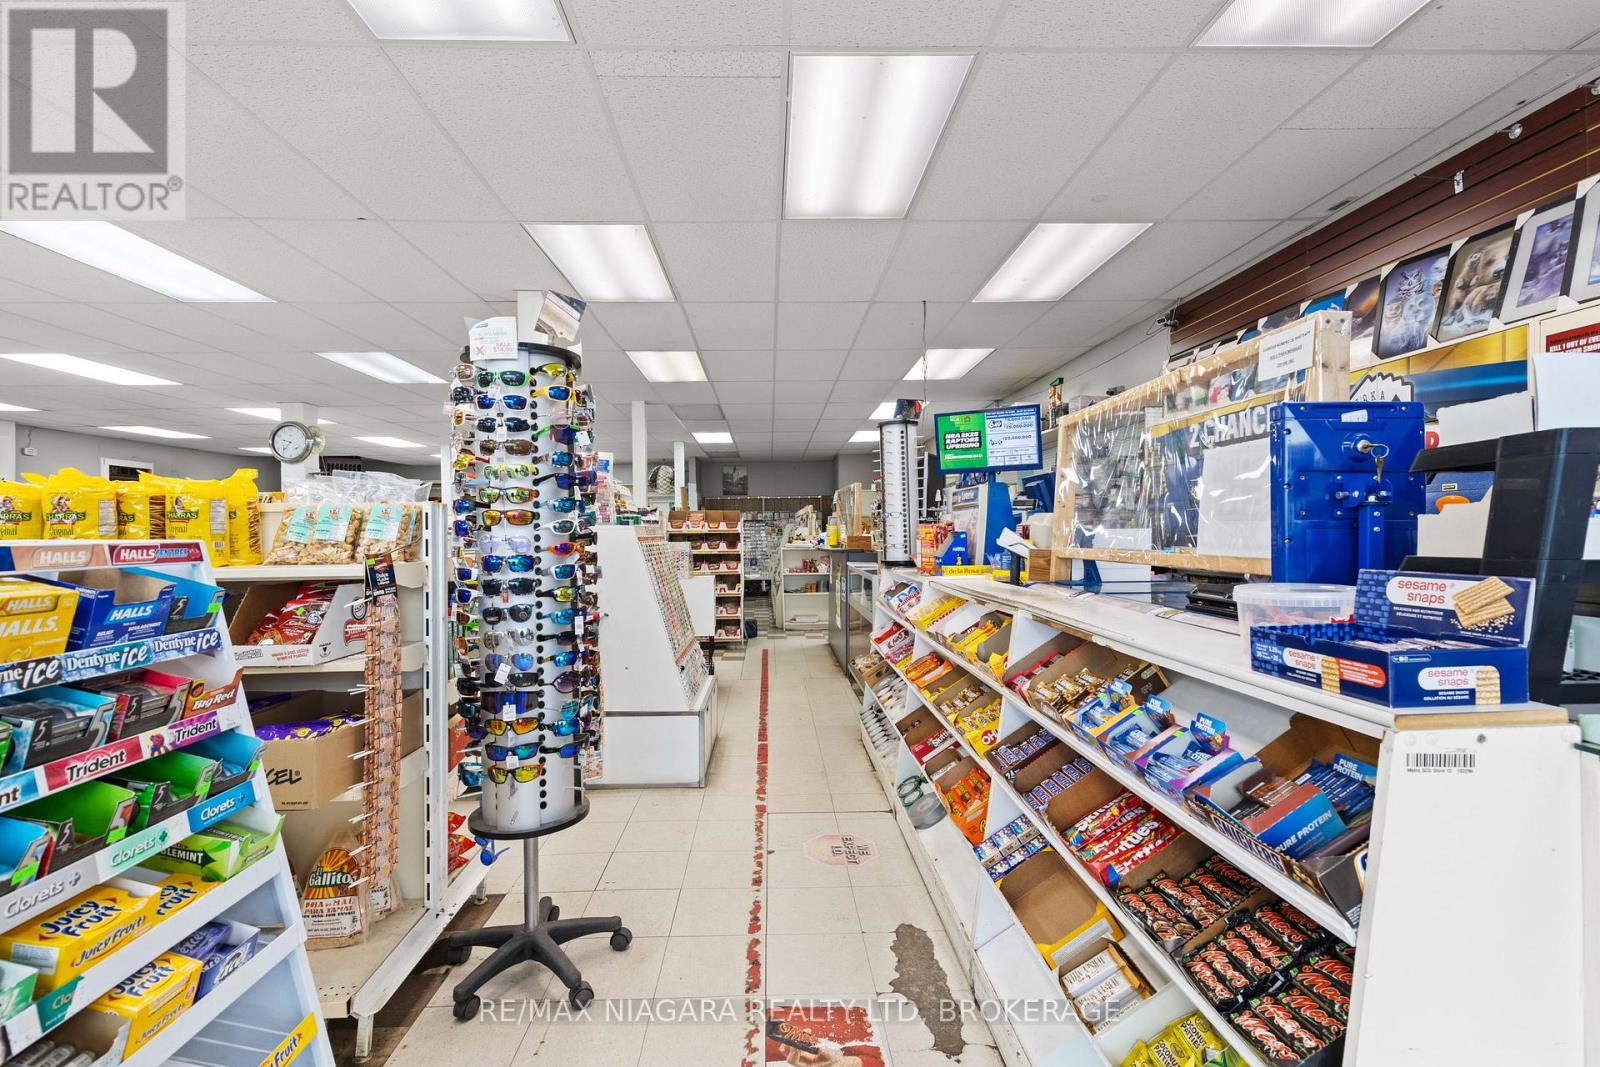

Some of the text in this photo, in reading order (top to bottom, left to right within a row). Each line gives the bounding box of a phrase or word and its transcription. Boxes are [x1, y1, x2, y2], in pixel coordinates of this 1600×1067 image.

[1549, 345, 1561, 353] KILL
[1566, 340, 1579, 349] OUT
[1580, 338, 1588, 346] OF
[945, 437, 980, 445] RAPTORS
[945, 442, 980, 450] UPRISING
[38, 550, 88, 566] HALLS
[119, 548, 156, 561] HALLS
[1397, 580, 1447, 592] sesame
[6, 596, 53, 612] HALLS
[1407, 592, 1446, 606] snaps
[109, 605, 154, 621] HALLS
[154, 629, 219, 652] Dentyne ice
[66, 644, 149, 672] Dentyne ice
[1287, 650, 1316, 662] sesame
[1294, 660, 1316, 670] snaps
[22, 659, 60, 689] ice
[1427, 669, 1469, 678] sesame
[1438, 678, 1469, 688] snaps
[174, 718, 217, 743] Trident
[1199, 716, 1213, 727] PURE
[66, 751, 126, 782] Trident
[1332, 764, 1364, 783] PROTEIN
[1338, 758, 1359, 772] PURE
[200, 798, 235, 823] Clorets
[1297, 810, 1333, 840] PROTEIN
[110, 836, 156, 868] Clorets
[842, 836, 860, 865] EXPECT
[310, 872, 352, 886] Gallito
[3, 877, 65, 919] Clorets
[40, 900, 100, 935] Juicy
[60, 905, 122, 937] Fruit
[1255, 911, 1309, 943] Mars
[75, 915, 143, 967] Juicy Fruit
[1200, 950, 1250, 988] Mars
[1220, 937, 1272, 976] Mars
[126, 966, 176, 997] Fruit
[1186, 961, 1235, 999] Mars
[1282, 994, 1345, 1036] Mars
[1180, 1022, 1201, 1049] PATTIES
[1233, 1015, 1301, 1061] Mars
[274, 1036, 298, 1067] Fruit
